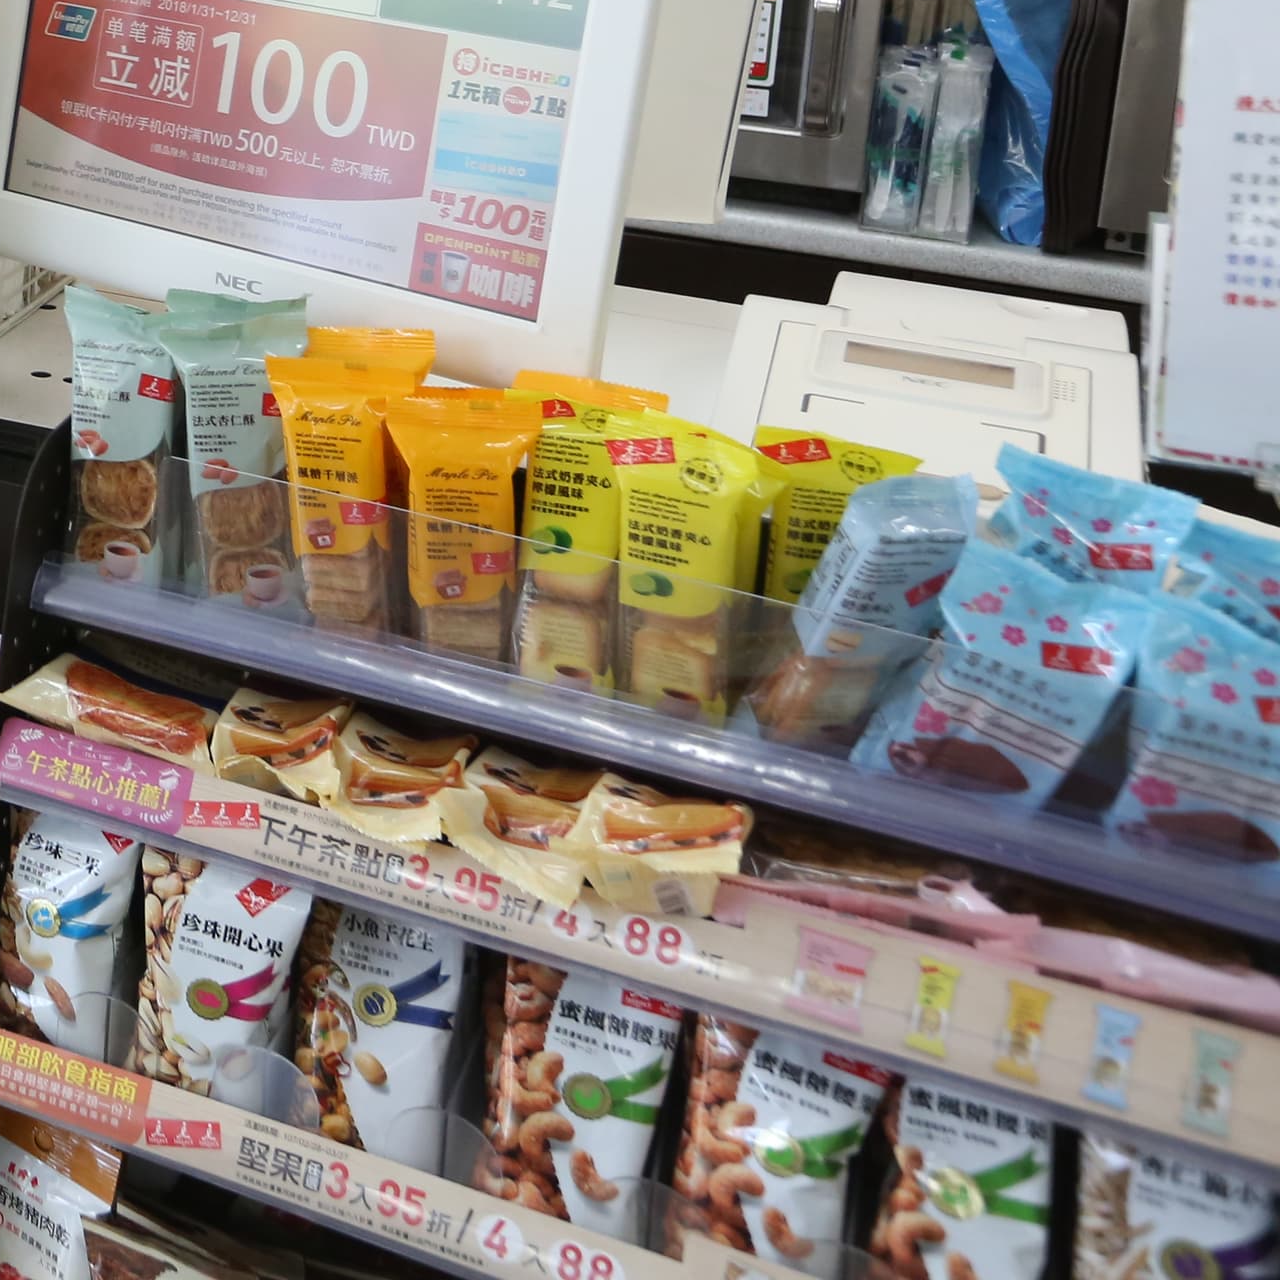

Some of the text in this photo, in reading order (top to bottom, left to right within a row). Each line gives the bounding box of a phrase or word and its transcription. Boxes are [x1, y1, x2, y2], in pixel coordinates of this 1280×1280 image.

[105, 17, 196, 54] 单笔满额
[99, 44, 192, 102] 立减
[213, 30, 368, 138] 100
[448, 79, 501, 107] 1元積
[531, 94, 567, 119] 1點
[235, 128, 278, 157] 500
[366, 125, 416, 152] TWD
[453, 195, 530, 236] 100
[215, 271, 263, 296] NEC
[468, 263, 537, 308] 咖啡
[192, 414, 255, 427] 法式杏仁酥
[340, 414, 362, 426] Pie
[471, 468, 499, 481] Pie
[533, 467, 612, 489] 法式奶香夾心
[531, 481, 584, 500] 檸檬風味
[181, 912, 284, 958] 珍珠開心果
